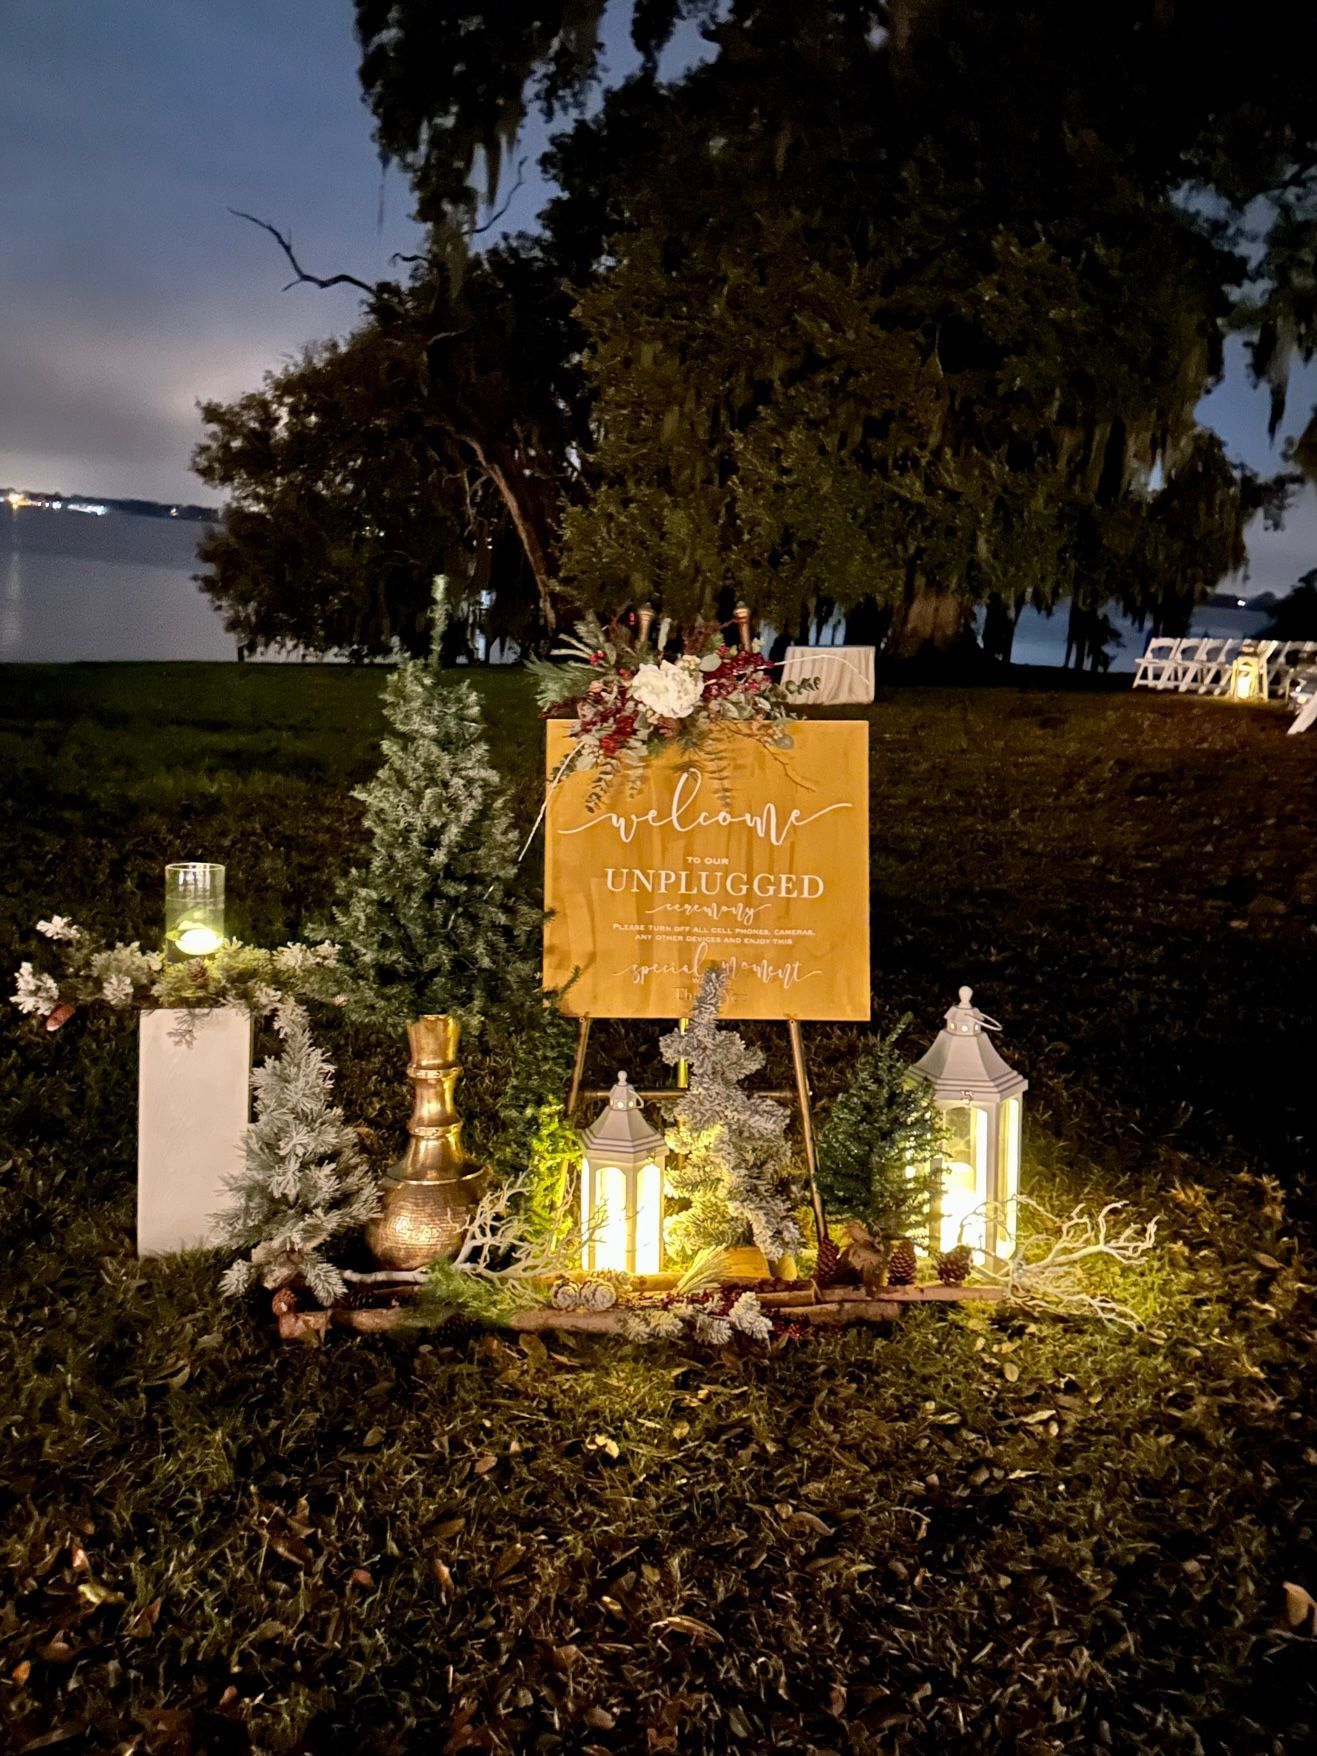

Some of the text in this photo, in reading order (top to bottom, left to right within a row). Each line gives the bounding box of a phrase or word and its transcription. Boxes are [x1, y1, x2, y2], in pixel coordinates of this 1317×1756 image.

[558, 768, 853, 846] welcome
[605, 868, 824, 898] UNPLUGGED
[612, 923, 645, 931] PLEASE
[648, 924, 672, 932] TURN
[645, 902, 772, 926] ceremony
[686, 935, 721, 943] DEVICES
[611, 942, 822, 990] special moment
